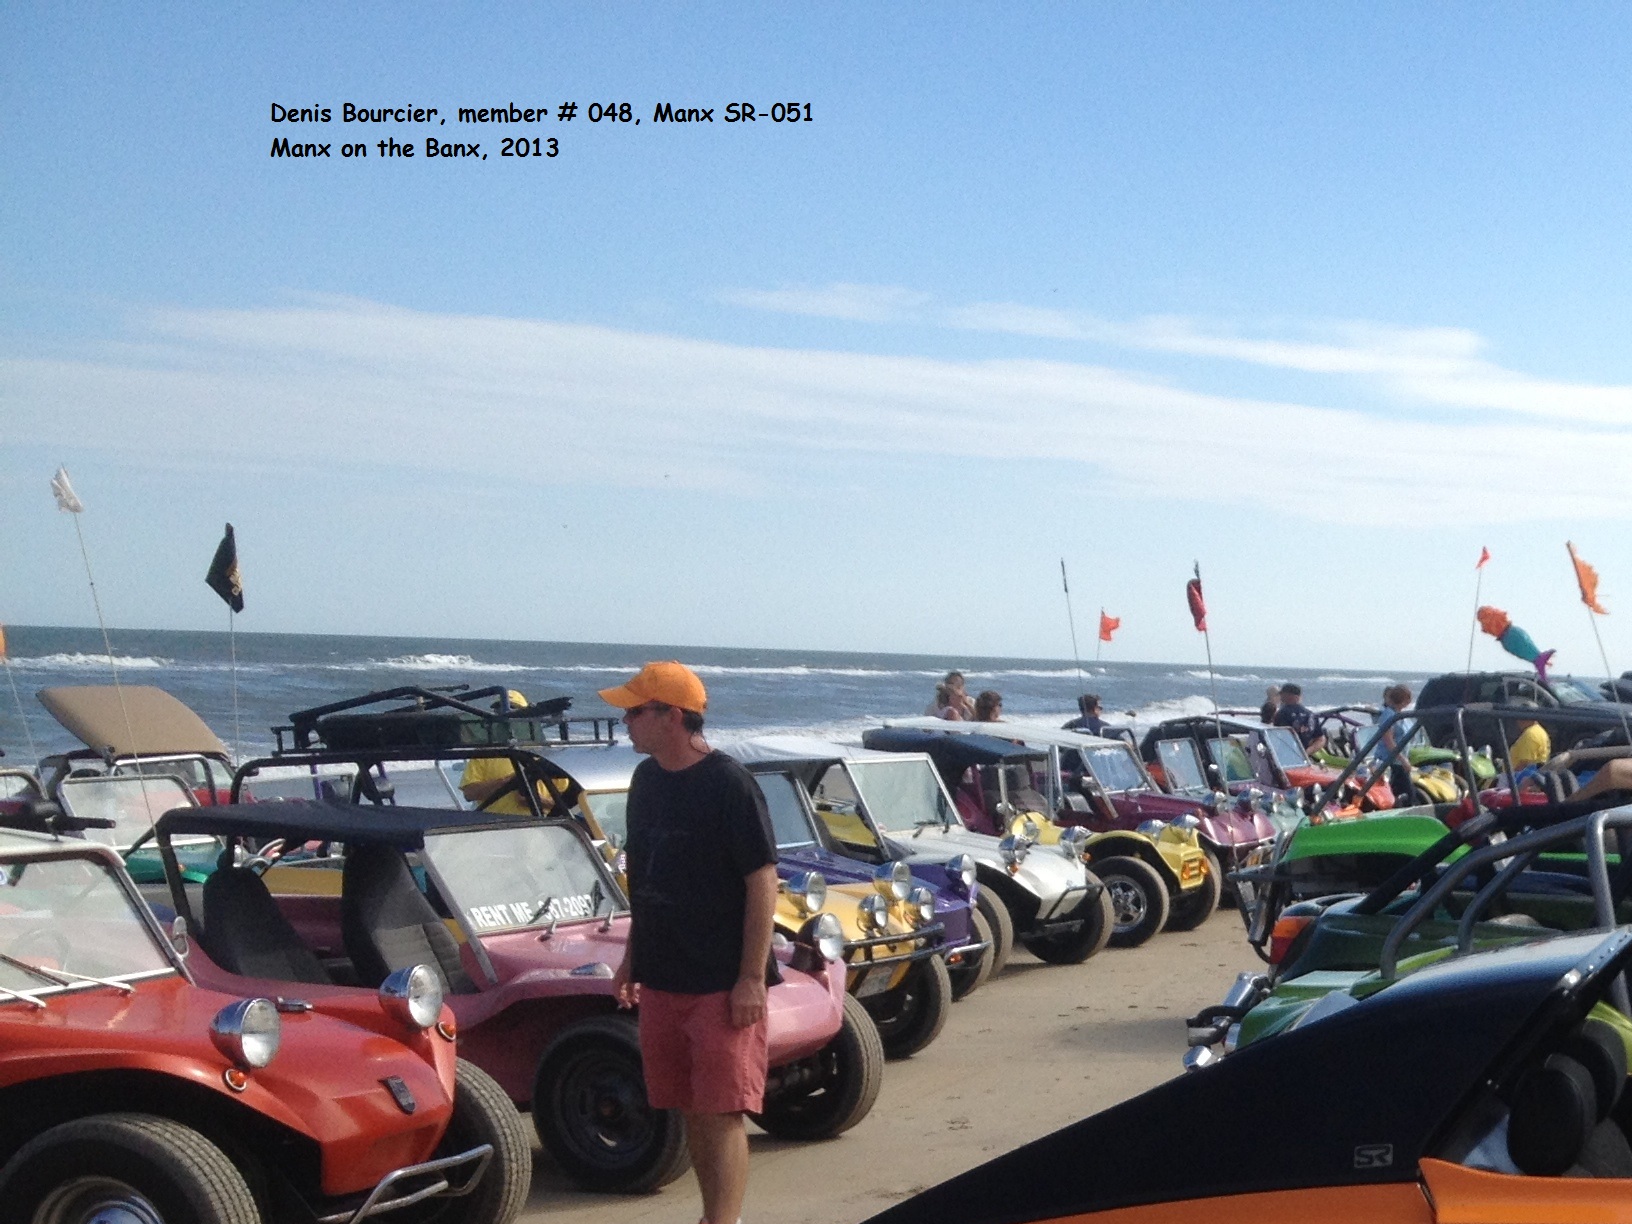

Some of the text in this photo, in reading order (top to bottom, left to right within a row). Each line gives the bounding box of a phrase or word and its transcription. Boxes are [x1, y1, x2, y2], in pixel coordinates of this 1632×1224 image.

[470, 904, 513, 928] RENT
[509, 902, 534, 923] ME
[1355, 1144, 1393, 1167] SR
